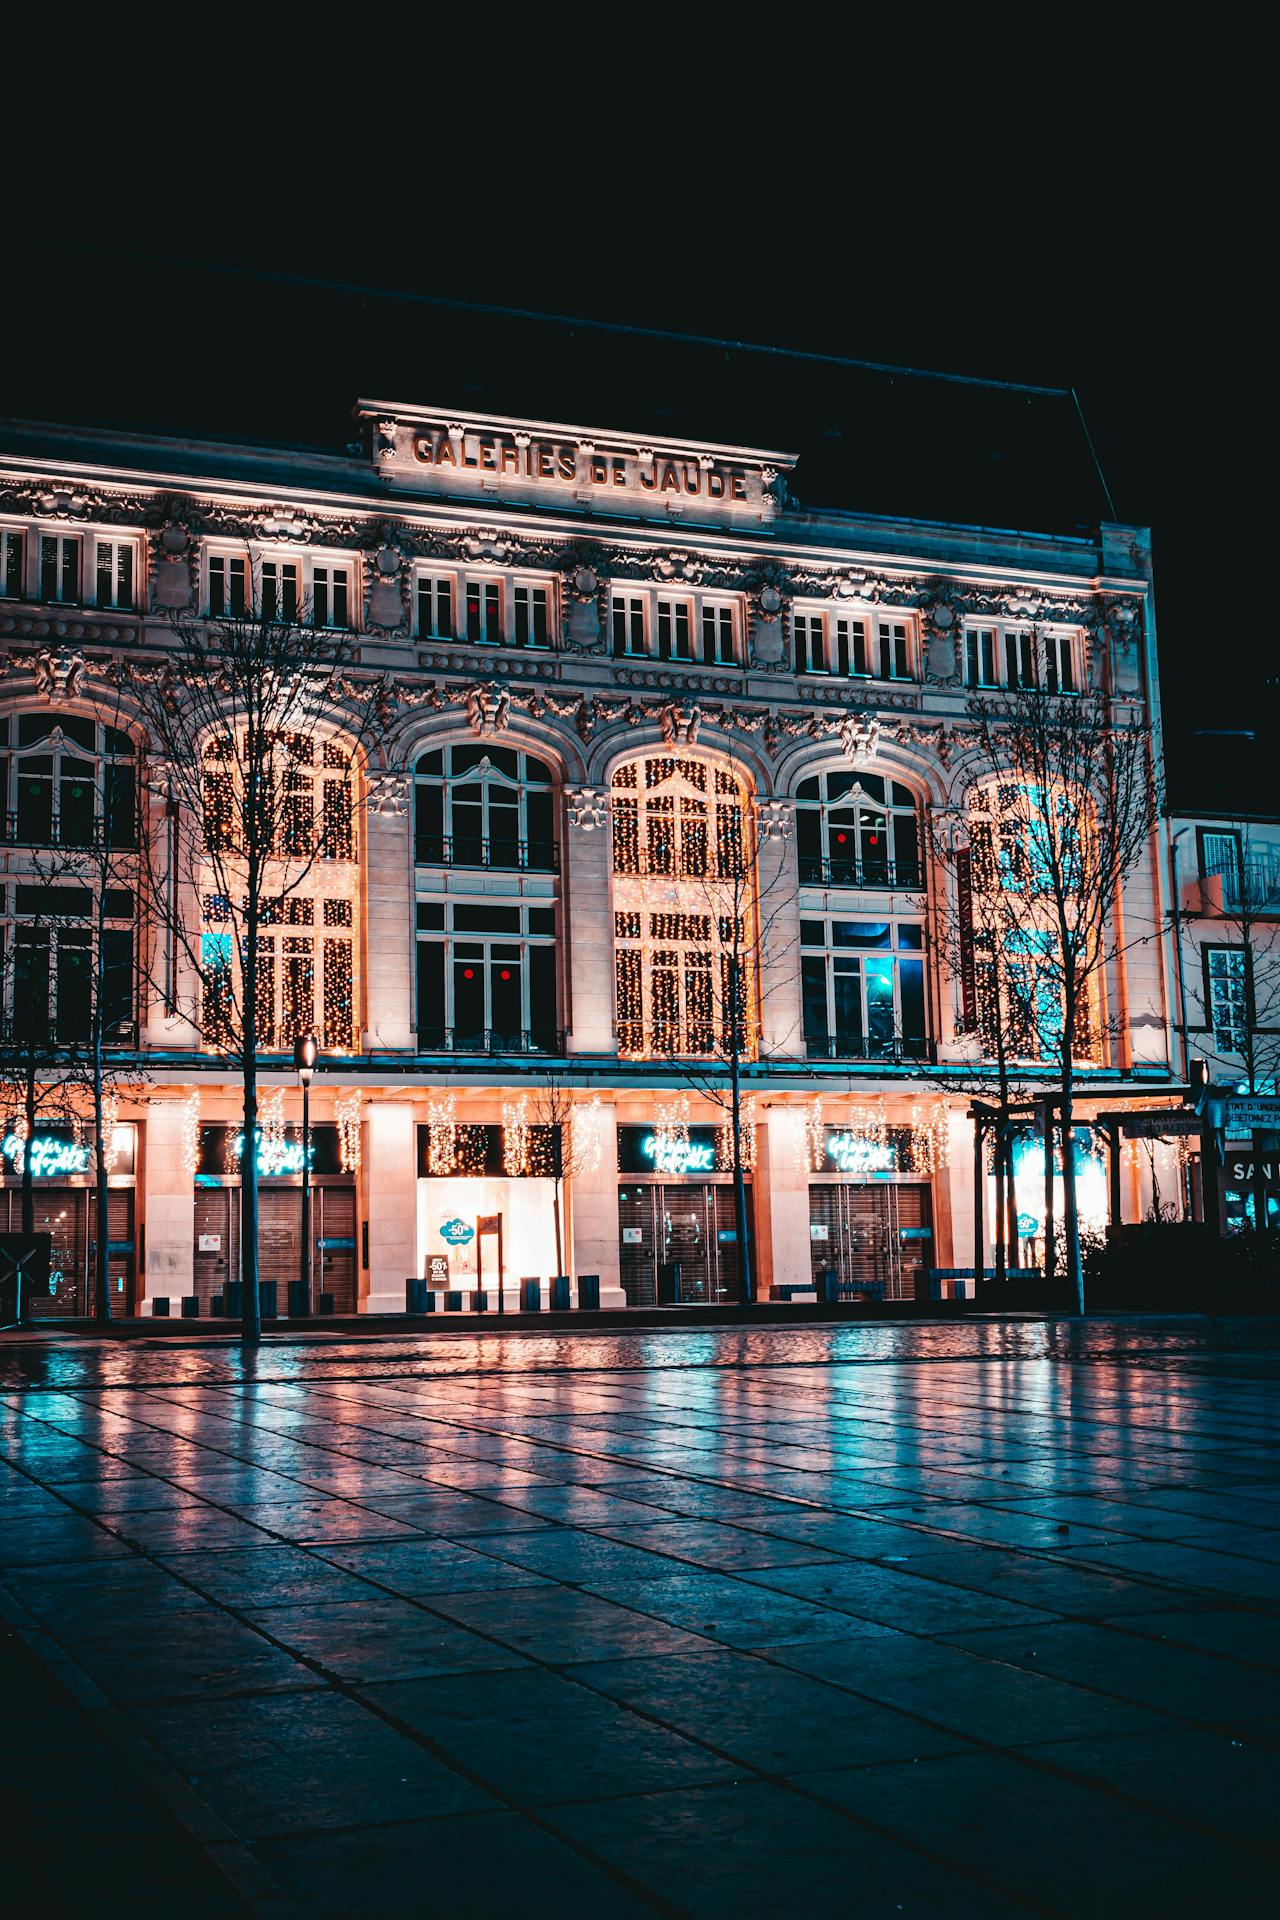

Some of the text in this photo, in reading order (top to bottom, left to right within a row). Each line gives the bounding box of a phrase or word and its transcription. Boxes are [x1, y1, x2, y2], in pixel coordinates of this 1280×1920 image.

[412, 436, 749, 502] GALERIES DE JAUDE
